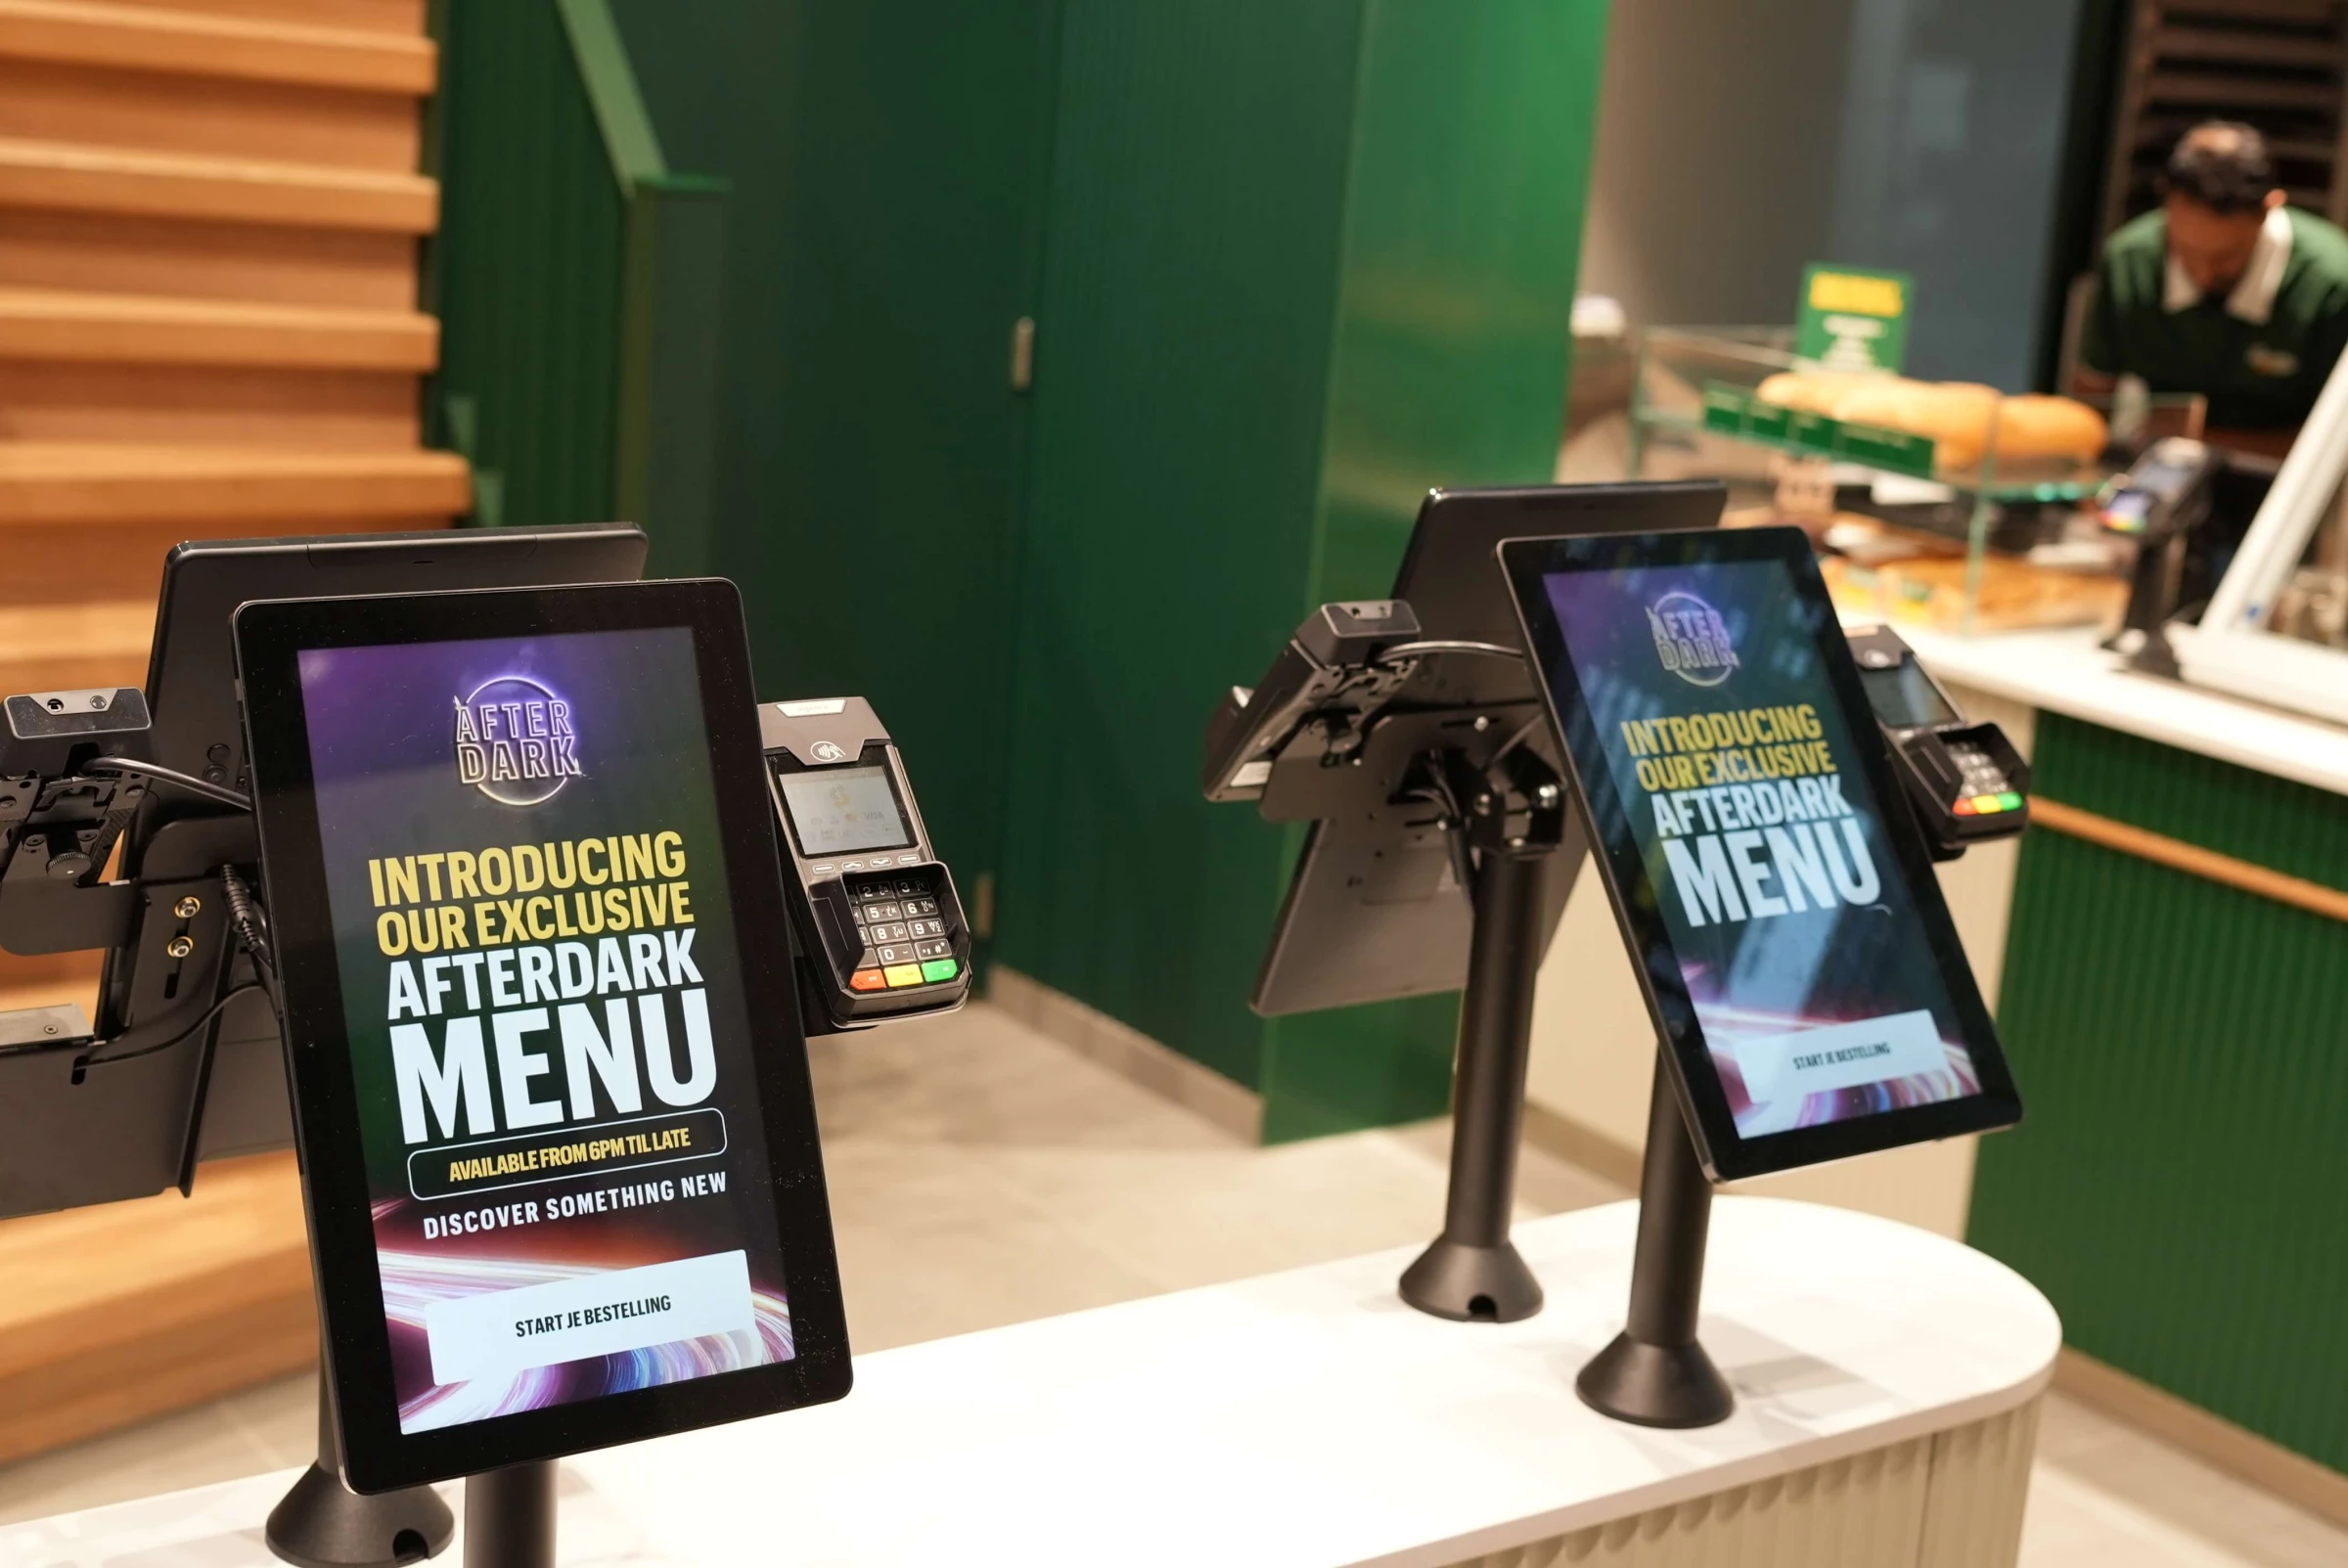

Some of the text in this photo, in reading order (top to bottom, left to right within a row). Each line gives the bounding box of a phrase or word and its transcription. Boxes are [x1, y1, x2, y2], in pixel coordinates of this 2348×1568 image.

[456, 699, 573, 742] AFTER
[1620, 703, 1824, 756] INTRODUCING
[457, 736, 578, 784] DARK
[1635, 740, 1837, 792] OUR EXCLUSIVE
[1650, 774, 1855, 837] AFTERDARK
[368, 830, 687, 908] INTRODUCING
[1661, 817, 1881, 928] MENU
[376, 882, 695, 957] OUR EXCLUSIVE
[870, 907, 880, 918] 5
[878, 928, 887, 939] 8
[908, 903, 918, 914] 6
[915, 923, 925, 934] 9
[387, 928, 704, 1020] AFTERDARK
[388, 988, 717, 1144] MENU
[449, 1128, 692, 1183] AVAILABLE FROM 6PM TIL LATE
[424, 1171, 726, 1239] DISCOVER SOMETHING NEW
[516, 1295, 672, 1337] START JE BESTELLING
